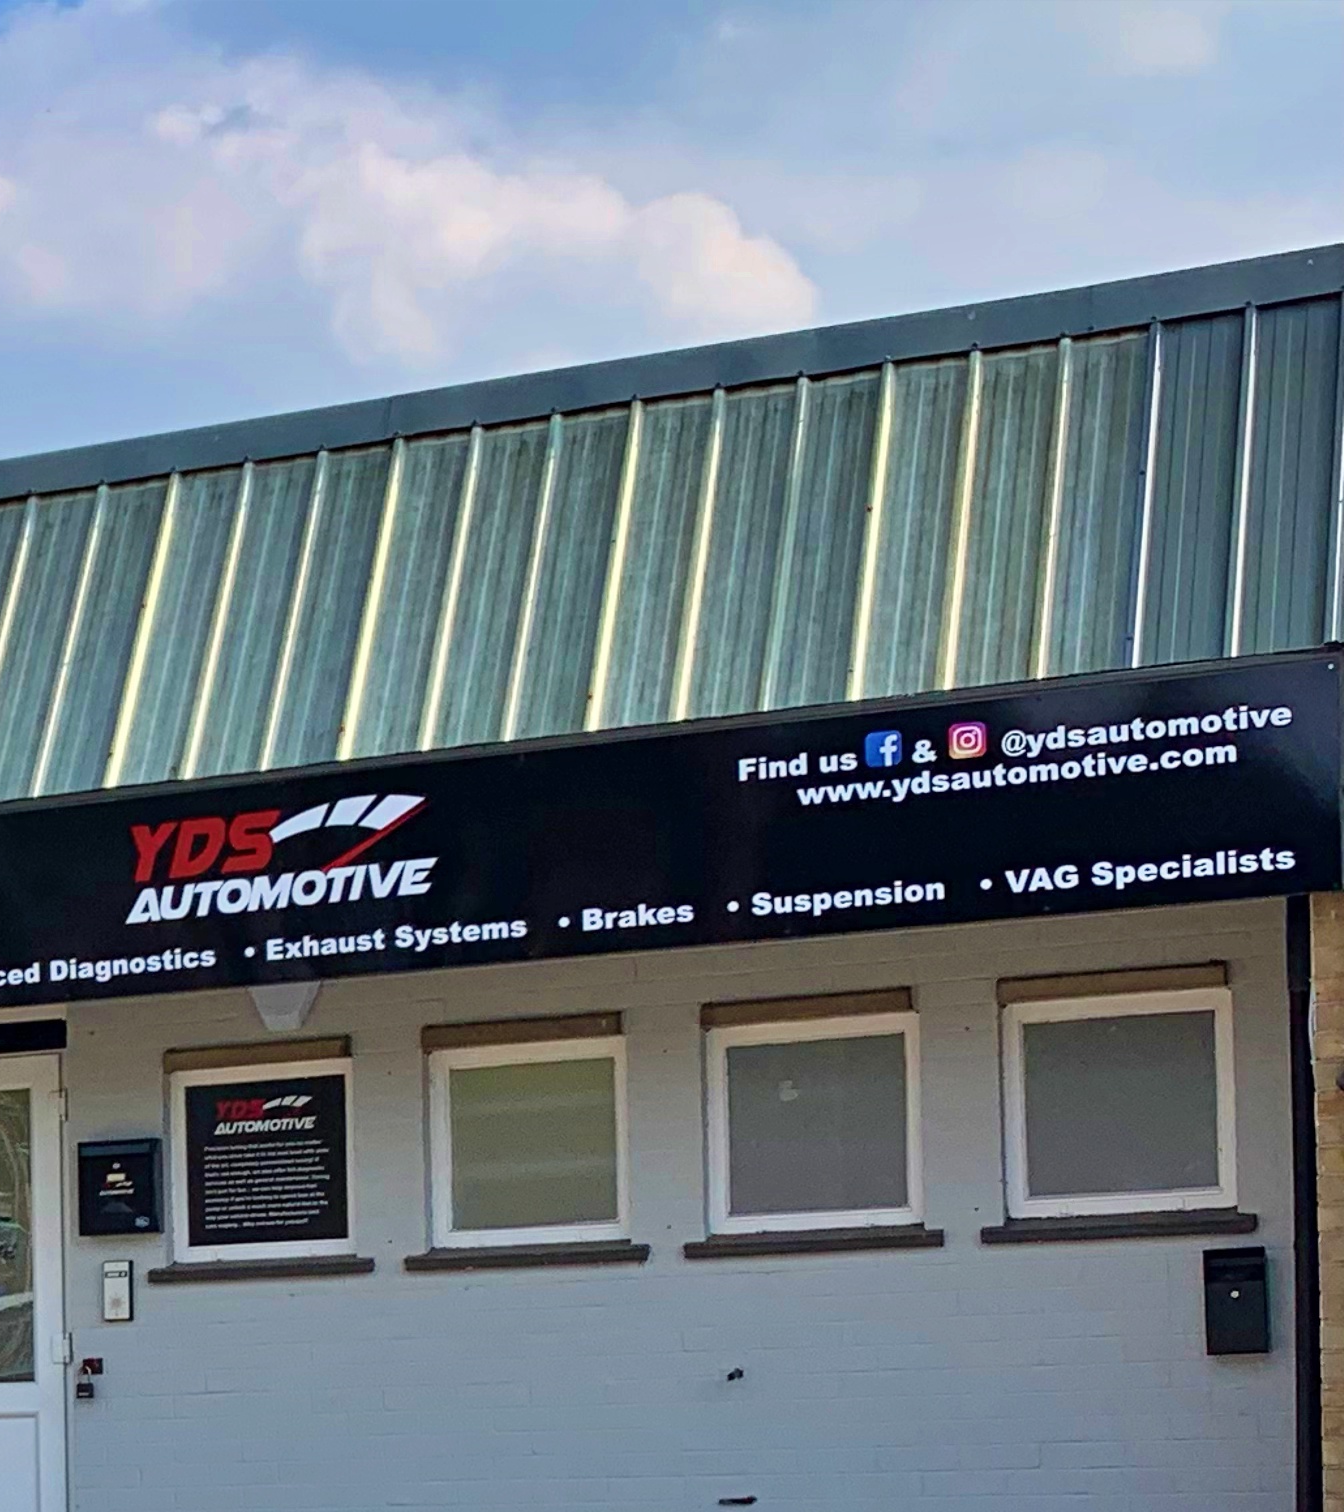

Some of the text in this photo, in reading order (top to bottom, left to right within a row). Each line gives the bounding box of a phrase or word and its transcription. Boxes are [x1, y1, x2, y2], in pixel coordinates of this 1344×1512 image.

[738, 752, 808, 782] Find
[819, 751, 858, 774] us
[911, 739, 938, 764] &
[1001, 705, 1293, 758] @ydsautomotive
[796, 741, 1238, 806] www.ydsautomotive.com
[130, 809, 281, 882] YDS
[49, 947, 217, 983] Diagnostics
[266, 928, 386, 962] Exhaust
[394, 916, 528, 953] Systems
[582, 903, 695, 932] Brakes
[751, 879, 946, 917] Suspension
[1004, 864, 1080, 894] VAG
[1091, 847, 1296, 889] Specialists
[125, 856, 439, 925] AUTOMOTIVE
[214, 1115, 317, 1136] AUTOMOTIVE
[215, 1098, 265, 1120] YDS
